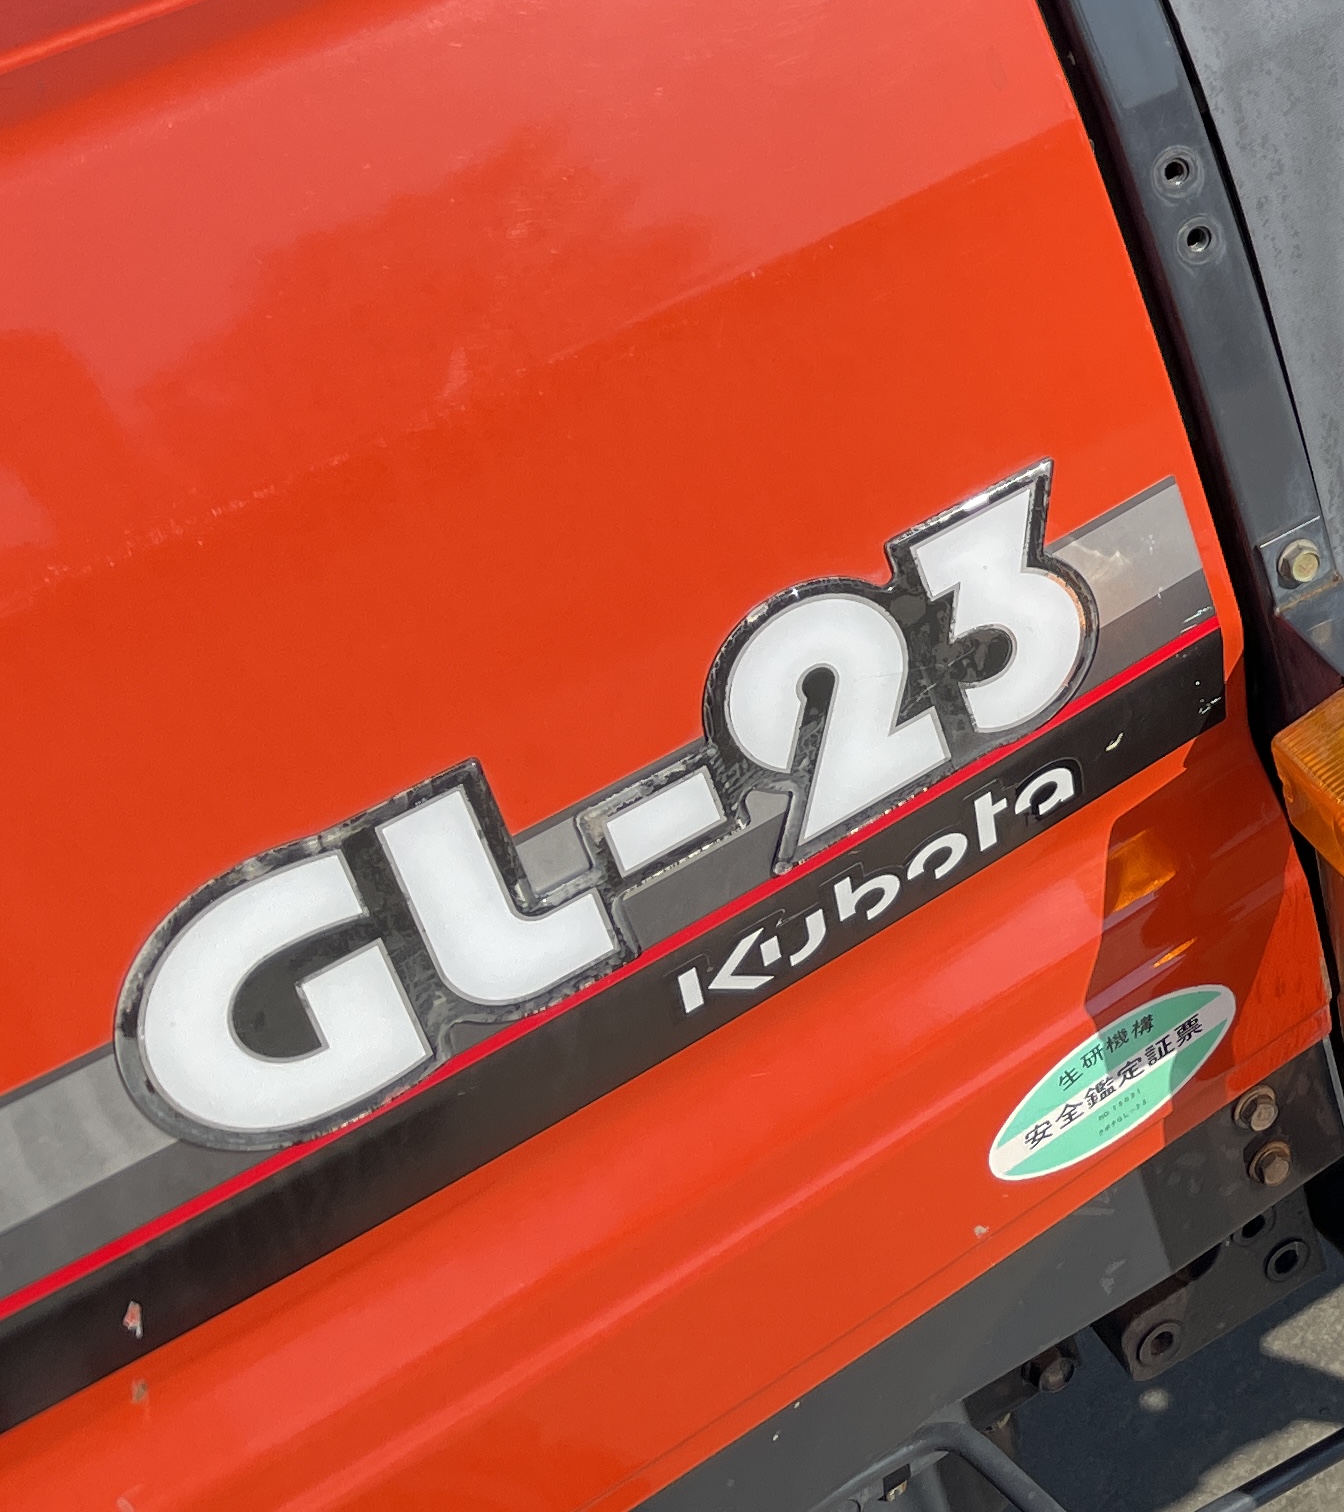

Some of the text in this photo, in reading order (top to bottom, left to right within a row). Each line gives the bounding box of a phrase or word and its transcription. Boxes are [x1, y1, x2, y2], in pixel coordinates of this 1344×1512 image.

[130, 476, 1086, 1136] GL-23
[676, 766, 1076, 1015] Kubota
[1023, 1012, 1203, 1151] 安全鑑定証票
[1058, 1013, 1155, 1092] 生研機構
